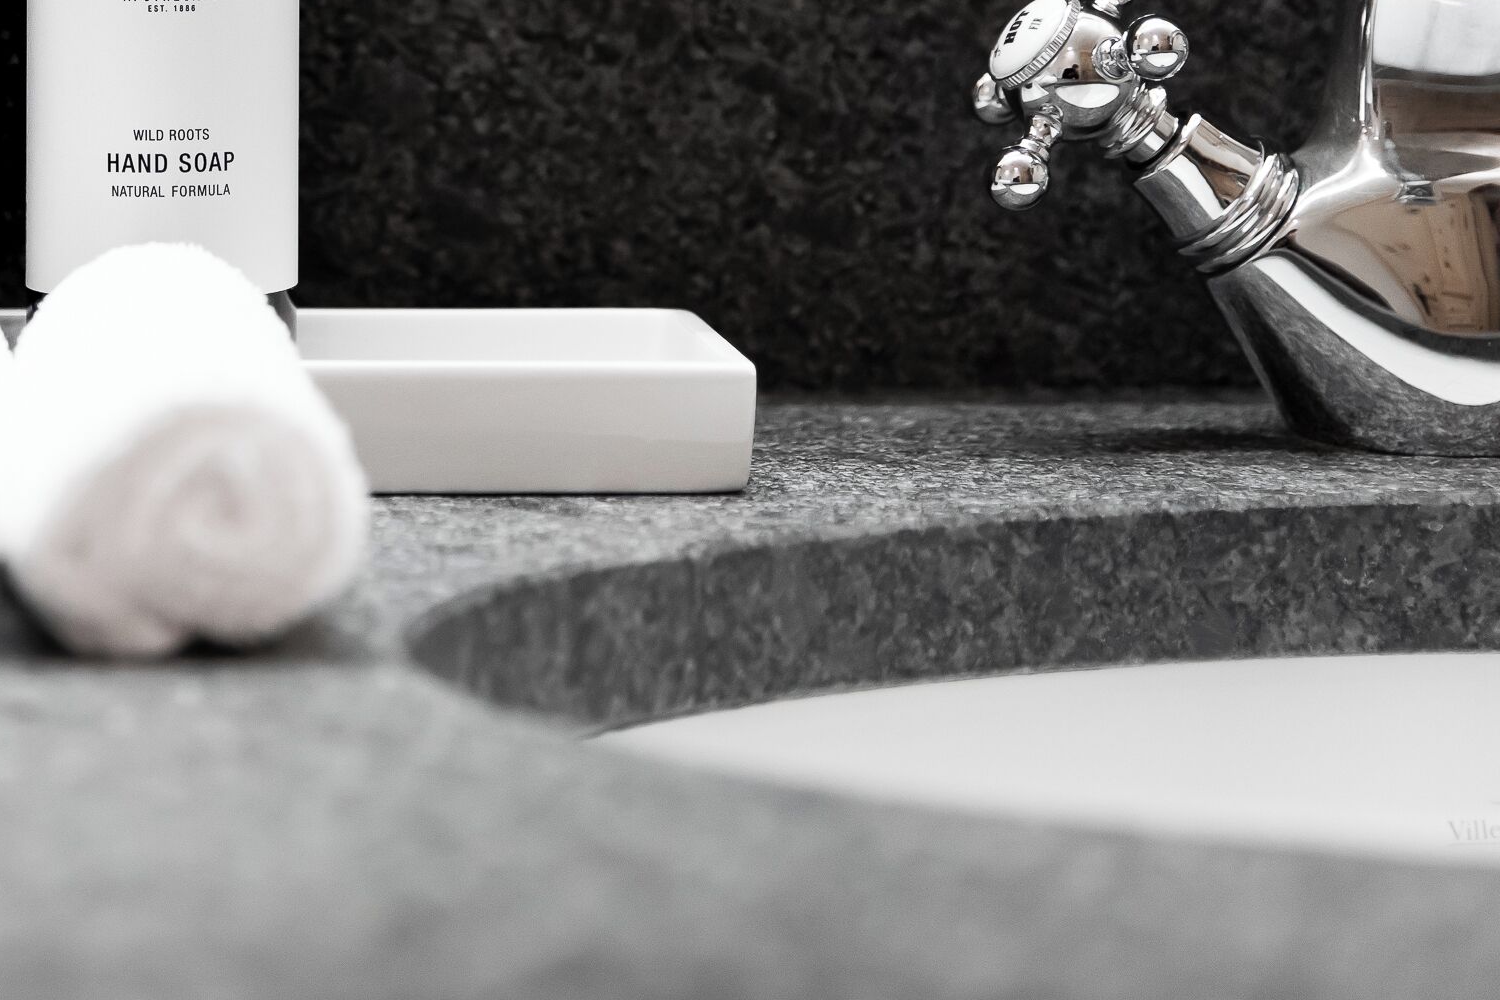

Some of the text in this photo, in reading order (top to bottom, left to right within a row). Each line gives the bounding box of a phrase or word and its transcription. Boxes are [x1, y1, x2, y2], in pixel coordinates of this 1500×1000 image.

[147, 4, 196, 13] EST. 1886
[1003, 10, 1030, 45] HOT
[132, 128, 210, 142] WILD ROOTS
[107, 151, 235, 174] HAND SOAP
[111, 183, 231, 198] NATURAL FORMULA
